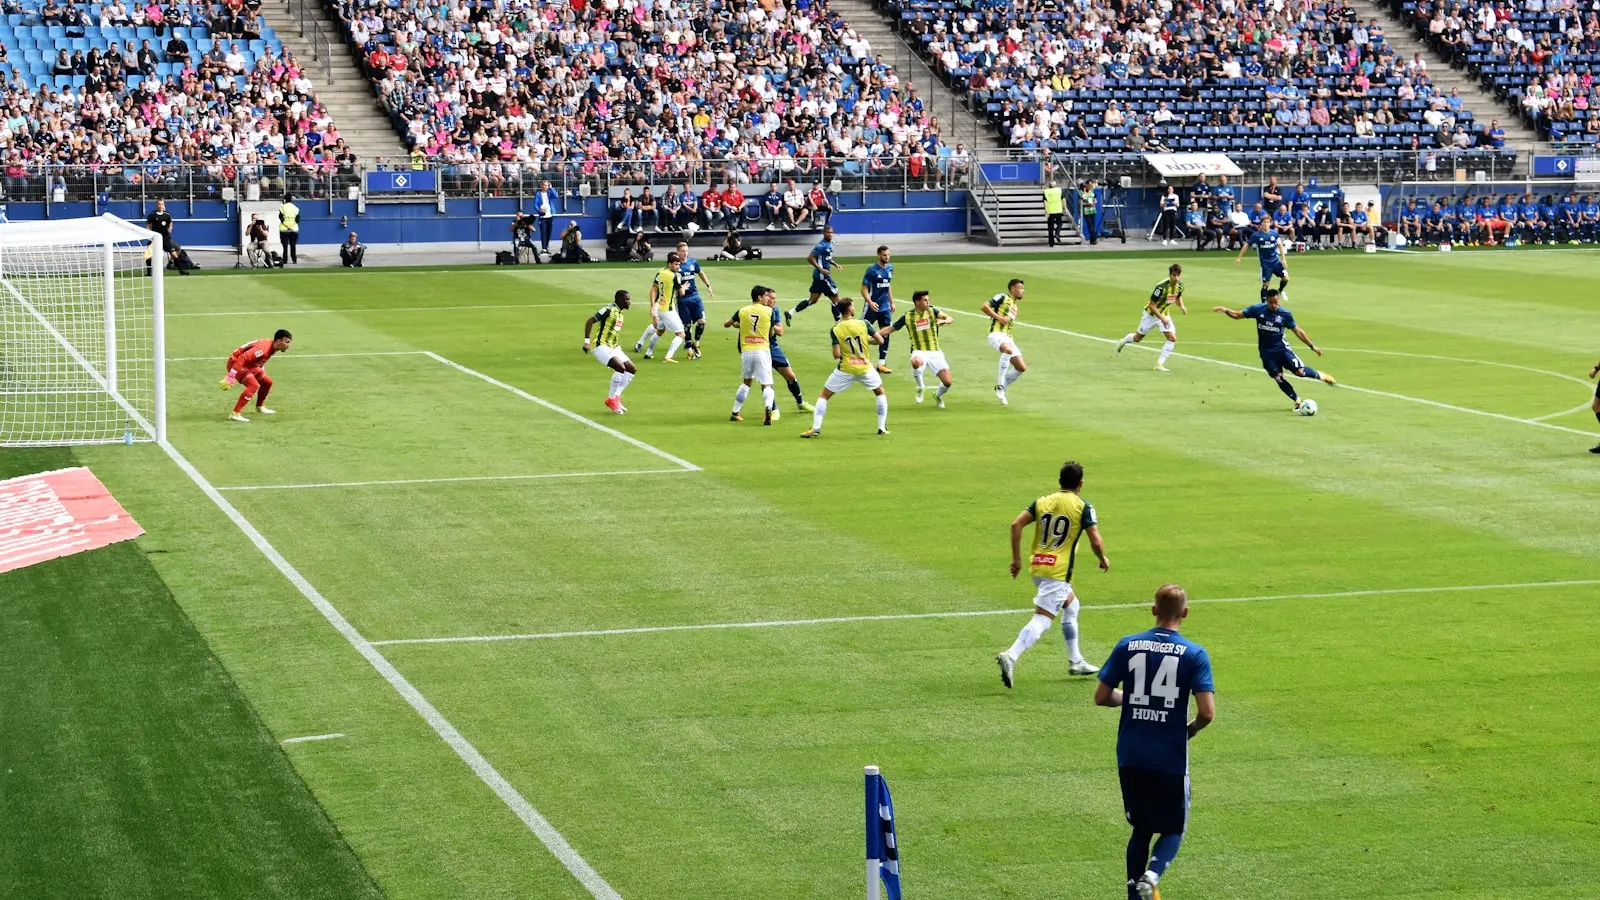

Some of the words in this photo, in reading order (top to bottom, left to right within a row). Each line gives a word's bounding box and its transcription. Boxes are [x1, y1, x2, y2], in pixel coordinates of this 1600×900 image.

[1209, 163, 1224, 171] 2
[750, 314, 760, 334] 7
[845, 335, 864, 355] 11
[1040, 513, 1071, 549] 19
[1127, 640, 1175, 654] HAMBURGER
[1174, 644, 1188, 656] SV
[1128, 652, 1180, 709] 14
[1132, 708, 1169, 723] HUNT
